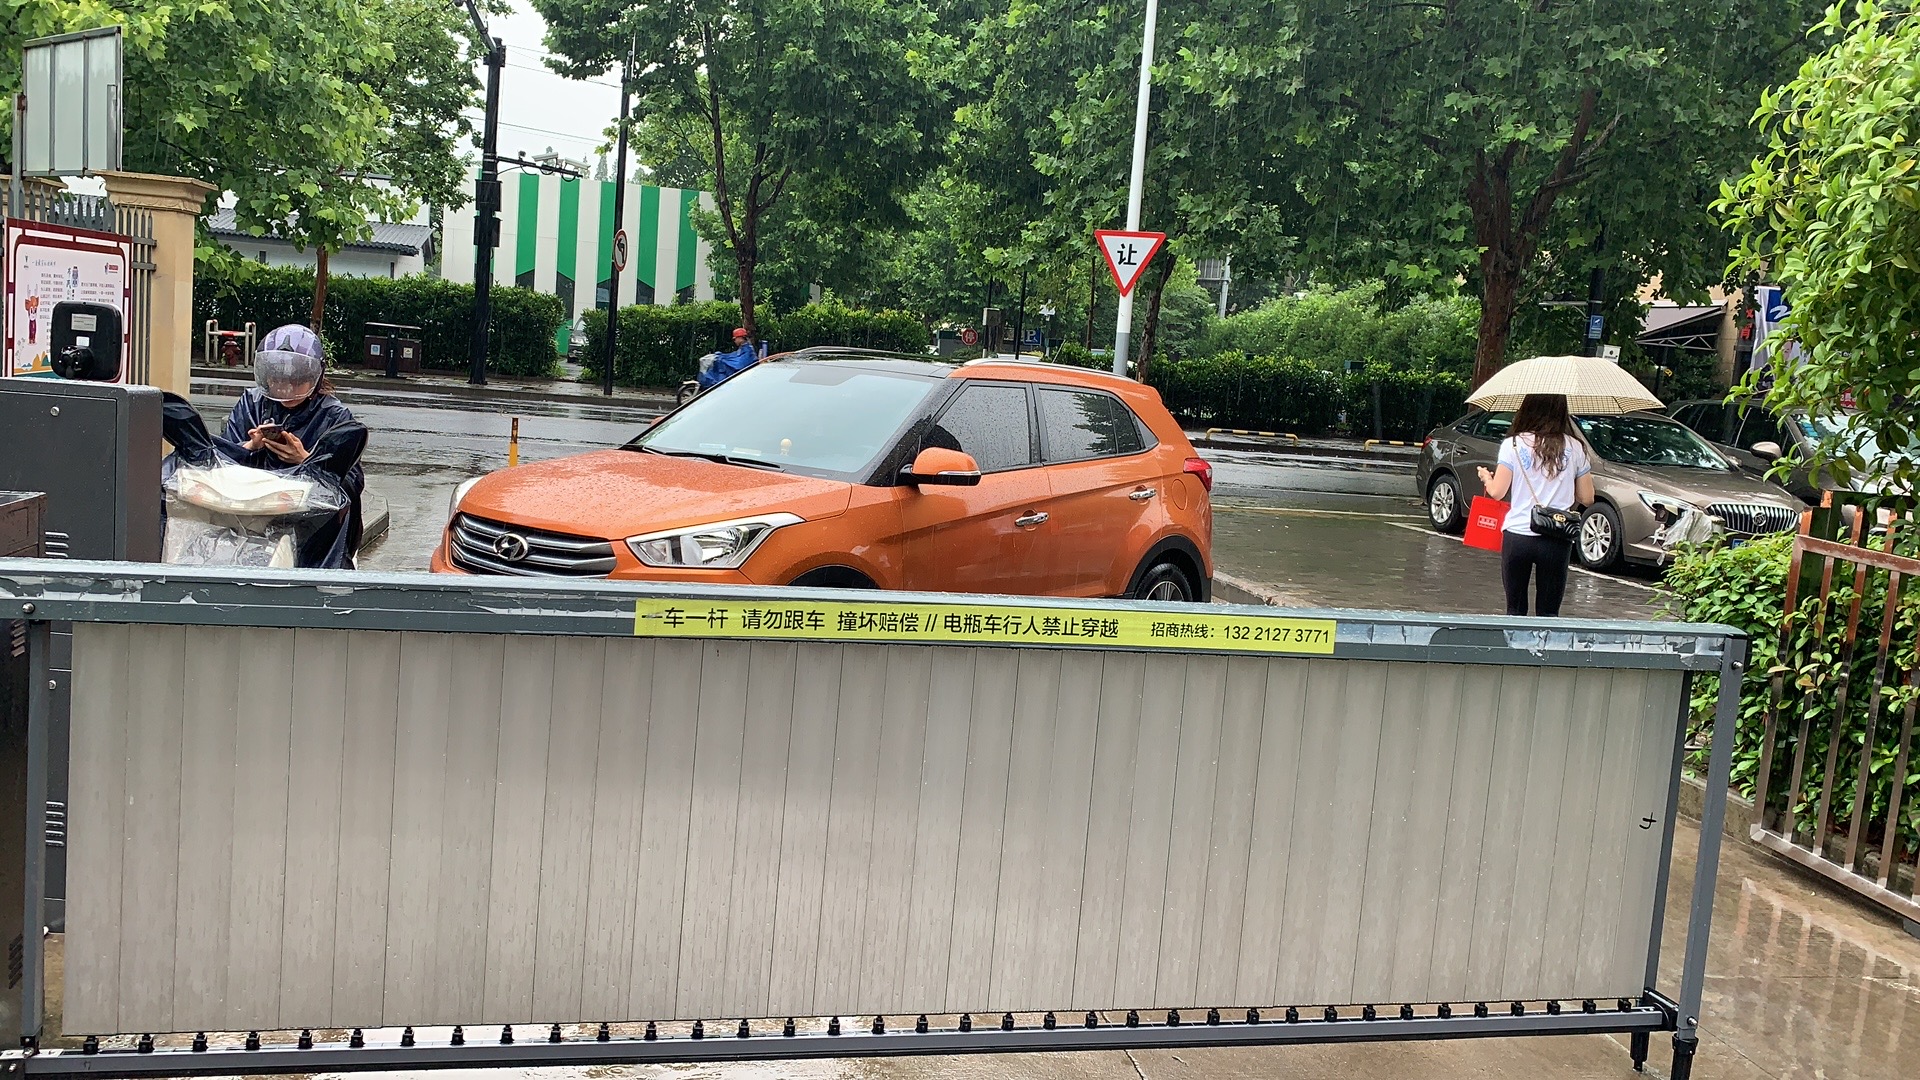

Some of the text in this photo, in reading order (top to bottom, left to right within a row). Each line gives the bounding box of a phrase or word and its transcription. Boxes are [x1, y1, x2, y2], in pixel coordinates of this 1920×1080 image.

[1117, 243, 1138, 266] 让
[964, 331, 975, 342] 停
[1025, 329, 1037, 342] P
[641, 606, 729, 629] 一车一杆
[741, 608, 826, 631] 请勿跟车
[837, 610, 919, 633] 撞坏赔偿
[943, 612, 1120, 638] 电瓶车行人禁止穿越
[1253, 626, 1291, 642] 2127
[1294, 628, 1329, 644] 3771
